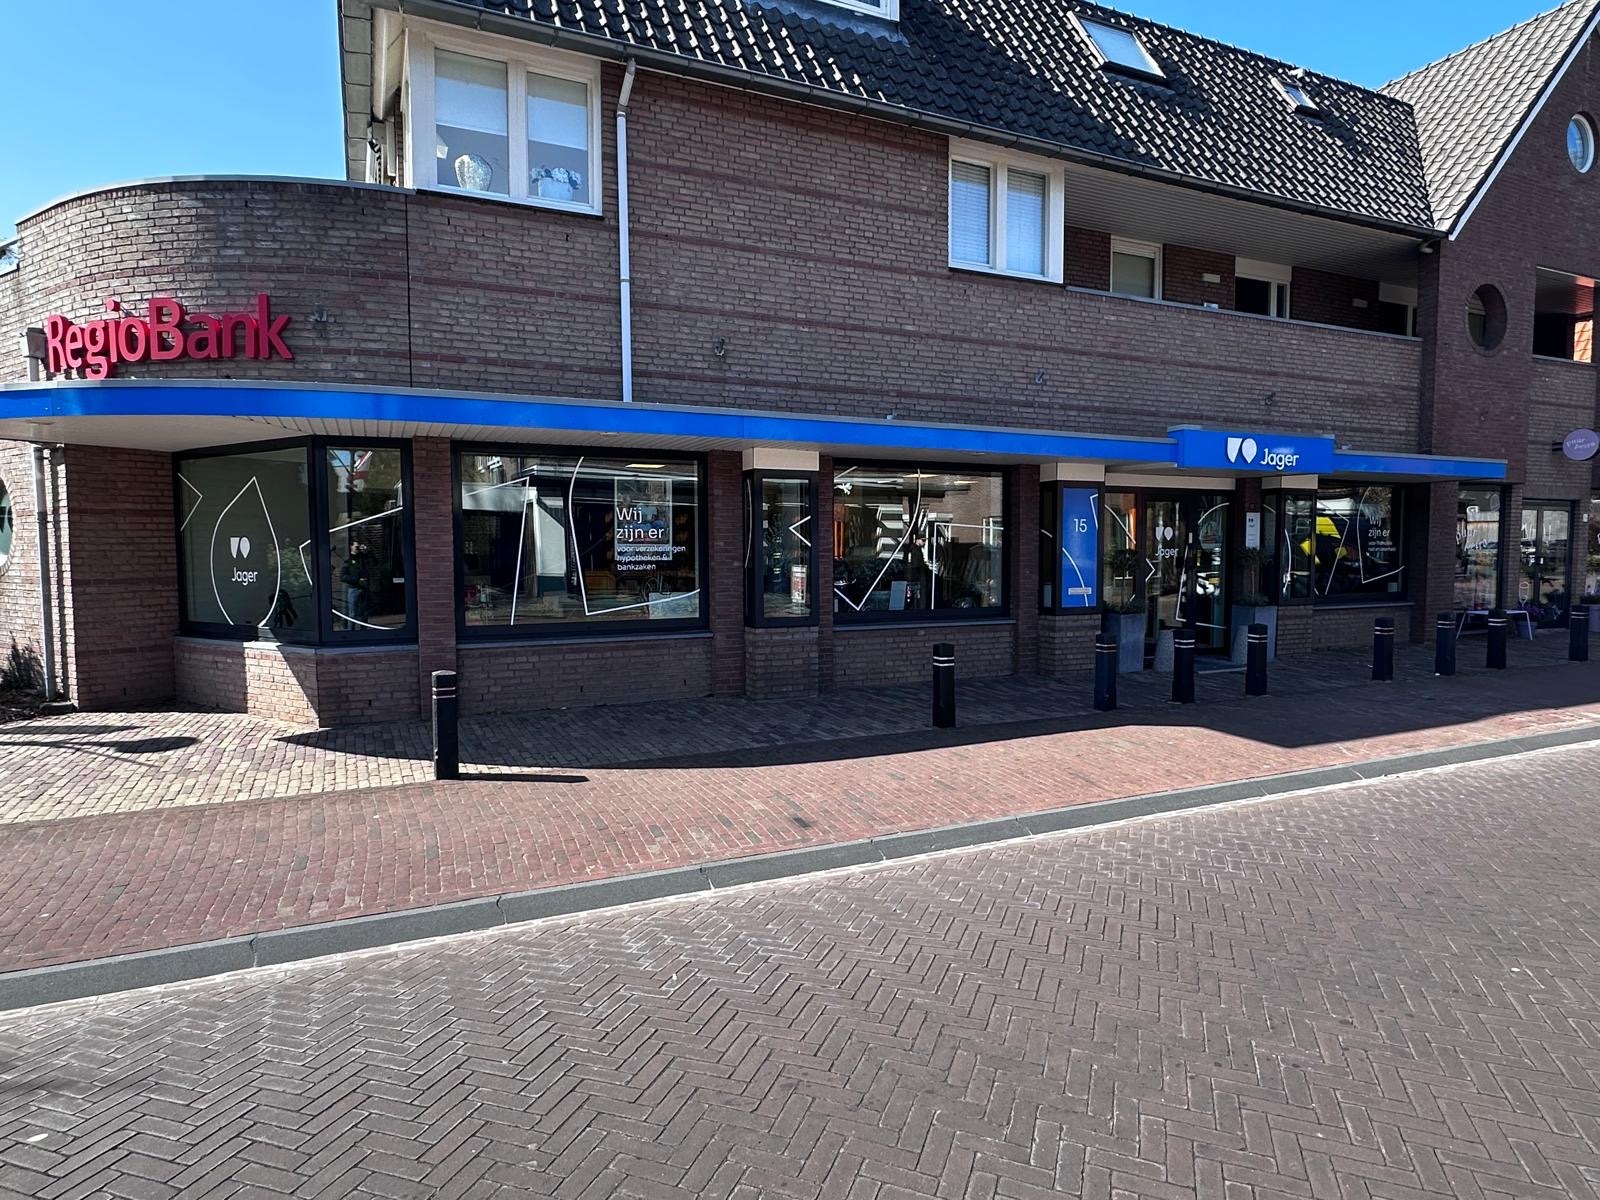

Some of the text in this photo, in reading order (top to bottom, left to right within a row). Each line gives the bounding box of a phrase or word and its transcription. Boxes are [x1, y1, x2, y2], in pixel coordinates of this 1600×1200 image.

[46, 293, 294, 381] RegioBank
[1260, 447, 1300, 470] Jager
[616, 507, 642, 523] Wij
[1073, 518, 1087, 533] 15
[616, 525, 665, 542] zijn er
[1368, 528, 1391, 539] zijn er
[617, 554, 661, 563] hypotheken
[1154, 547, 1179, 559] Jager
[617, 563, 656, 571] bankzaken
[231, 566, 259, 586] Jager
